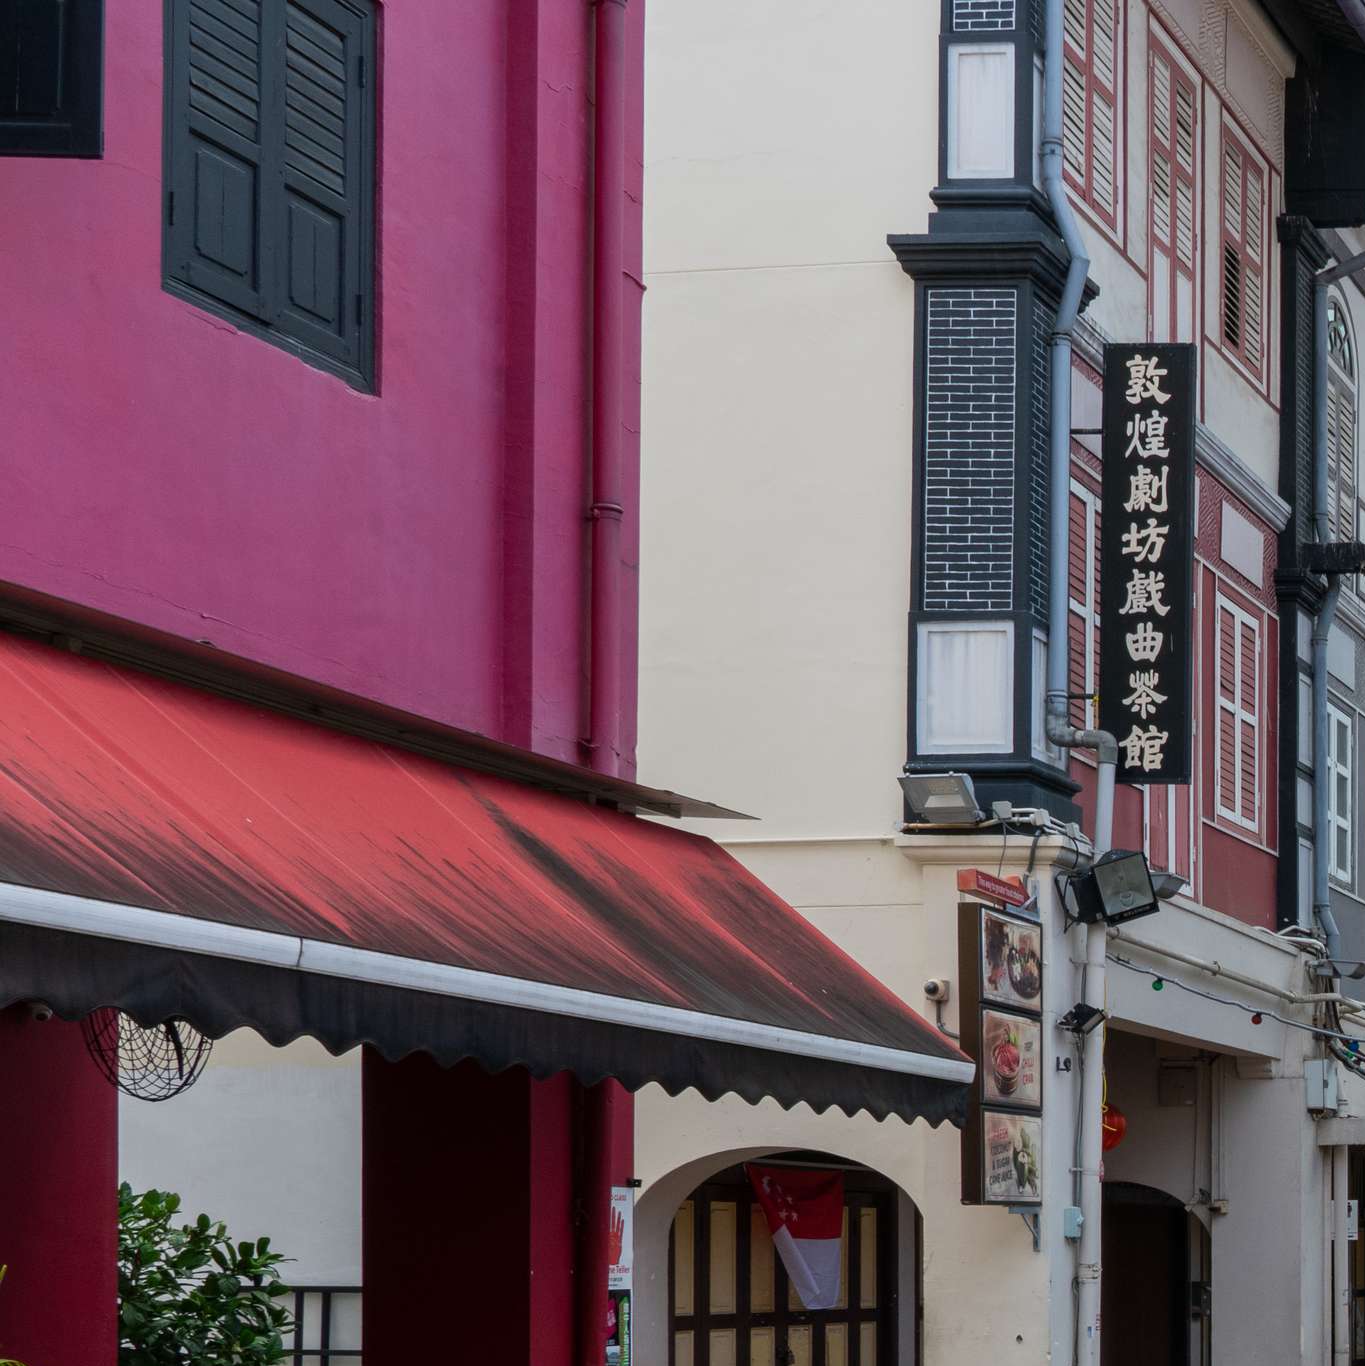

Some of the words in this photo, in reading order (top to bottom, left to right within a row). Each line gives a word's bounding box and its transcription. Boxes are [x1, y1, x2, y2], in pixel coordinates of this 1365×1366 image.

[1119, 354, 1172, 773] 敦煌劇坊戲曲茶館
